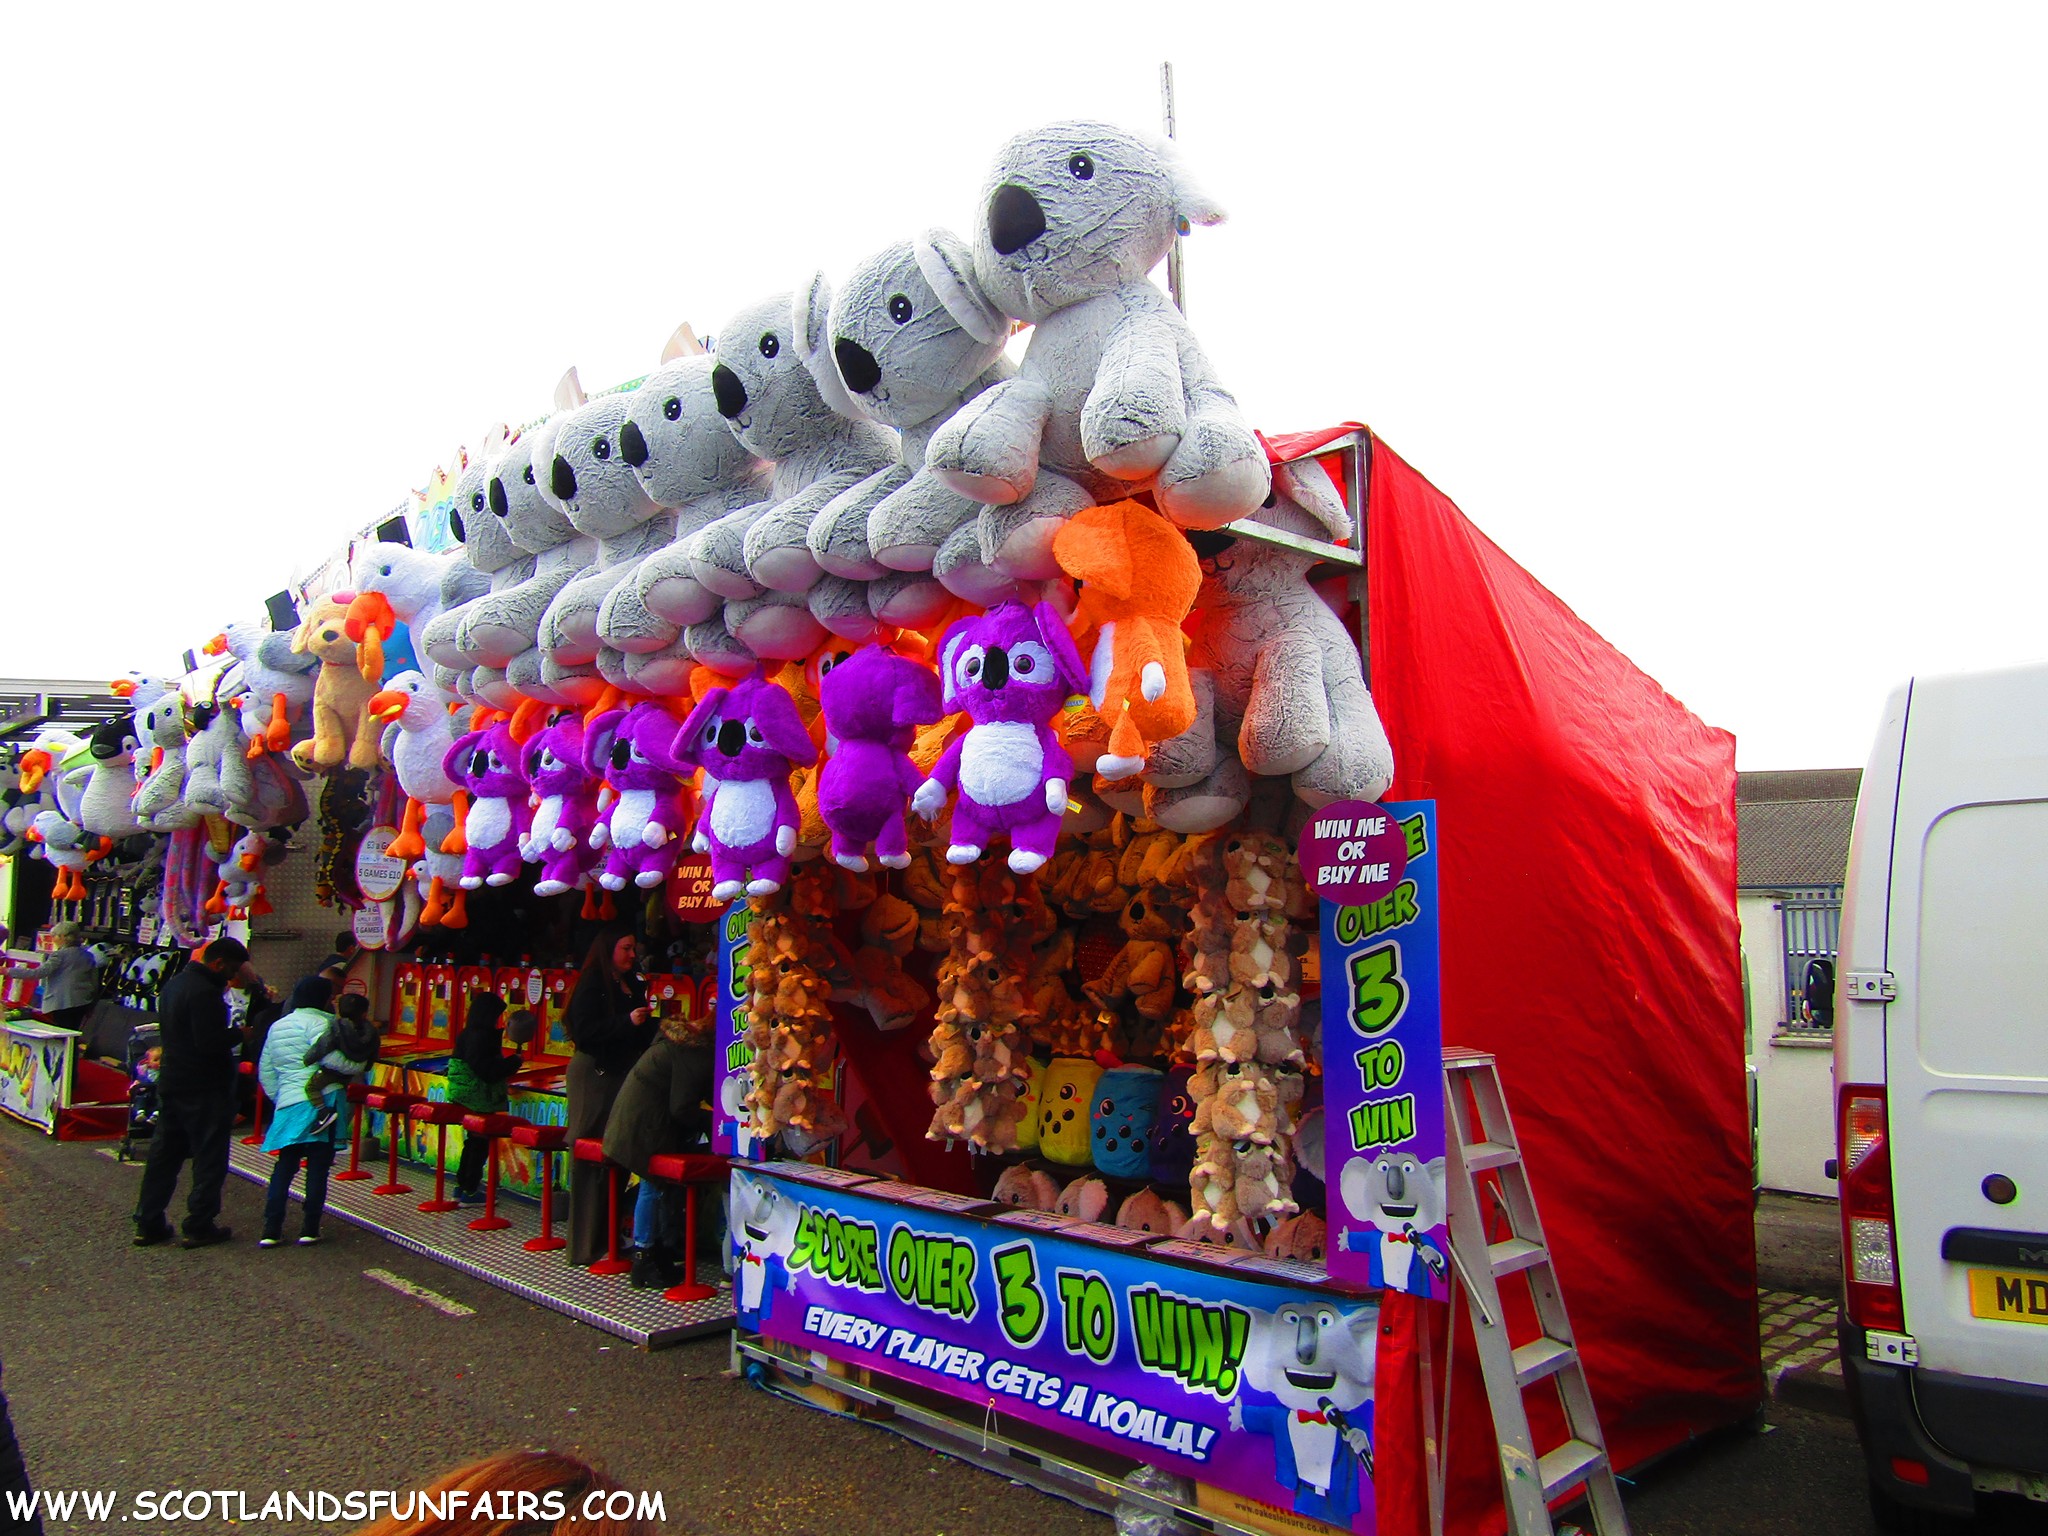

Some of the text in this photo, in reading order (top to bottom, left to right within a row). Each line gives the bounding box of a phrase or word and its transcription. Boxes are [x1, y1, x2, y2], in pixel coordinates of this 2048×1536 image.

[1314, 818, 1352, 839] WIN
[1355, 816, 1387, 838] ME
[1337, 841, 1366, 861] OR
[364, 869, 387, 879] GAMES
[389, 870, 401, 879] £10
[677, 866, 714, 879] WIN M
[1317, 862, 1390, 885] BUY ME
[692, 880, 710, 893] OR
[678, 896, 703, 909] BUY
[1335, 879, 1419, 945] OVER
[1348, 943, 1407, 1036] 3
[1355, 1039, 1404, 1092] TO
[1349, 1095, 1415, 1151] WIN
[785, 1204, 1252, 1400] SCORE OVER 3 TO WIN!
[804, 1306, 1215, 1460] EVERY PLAYER GETS A KOALA!
